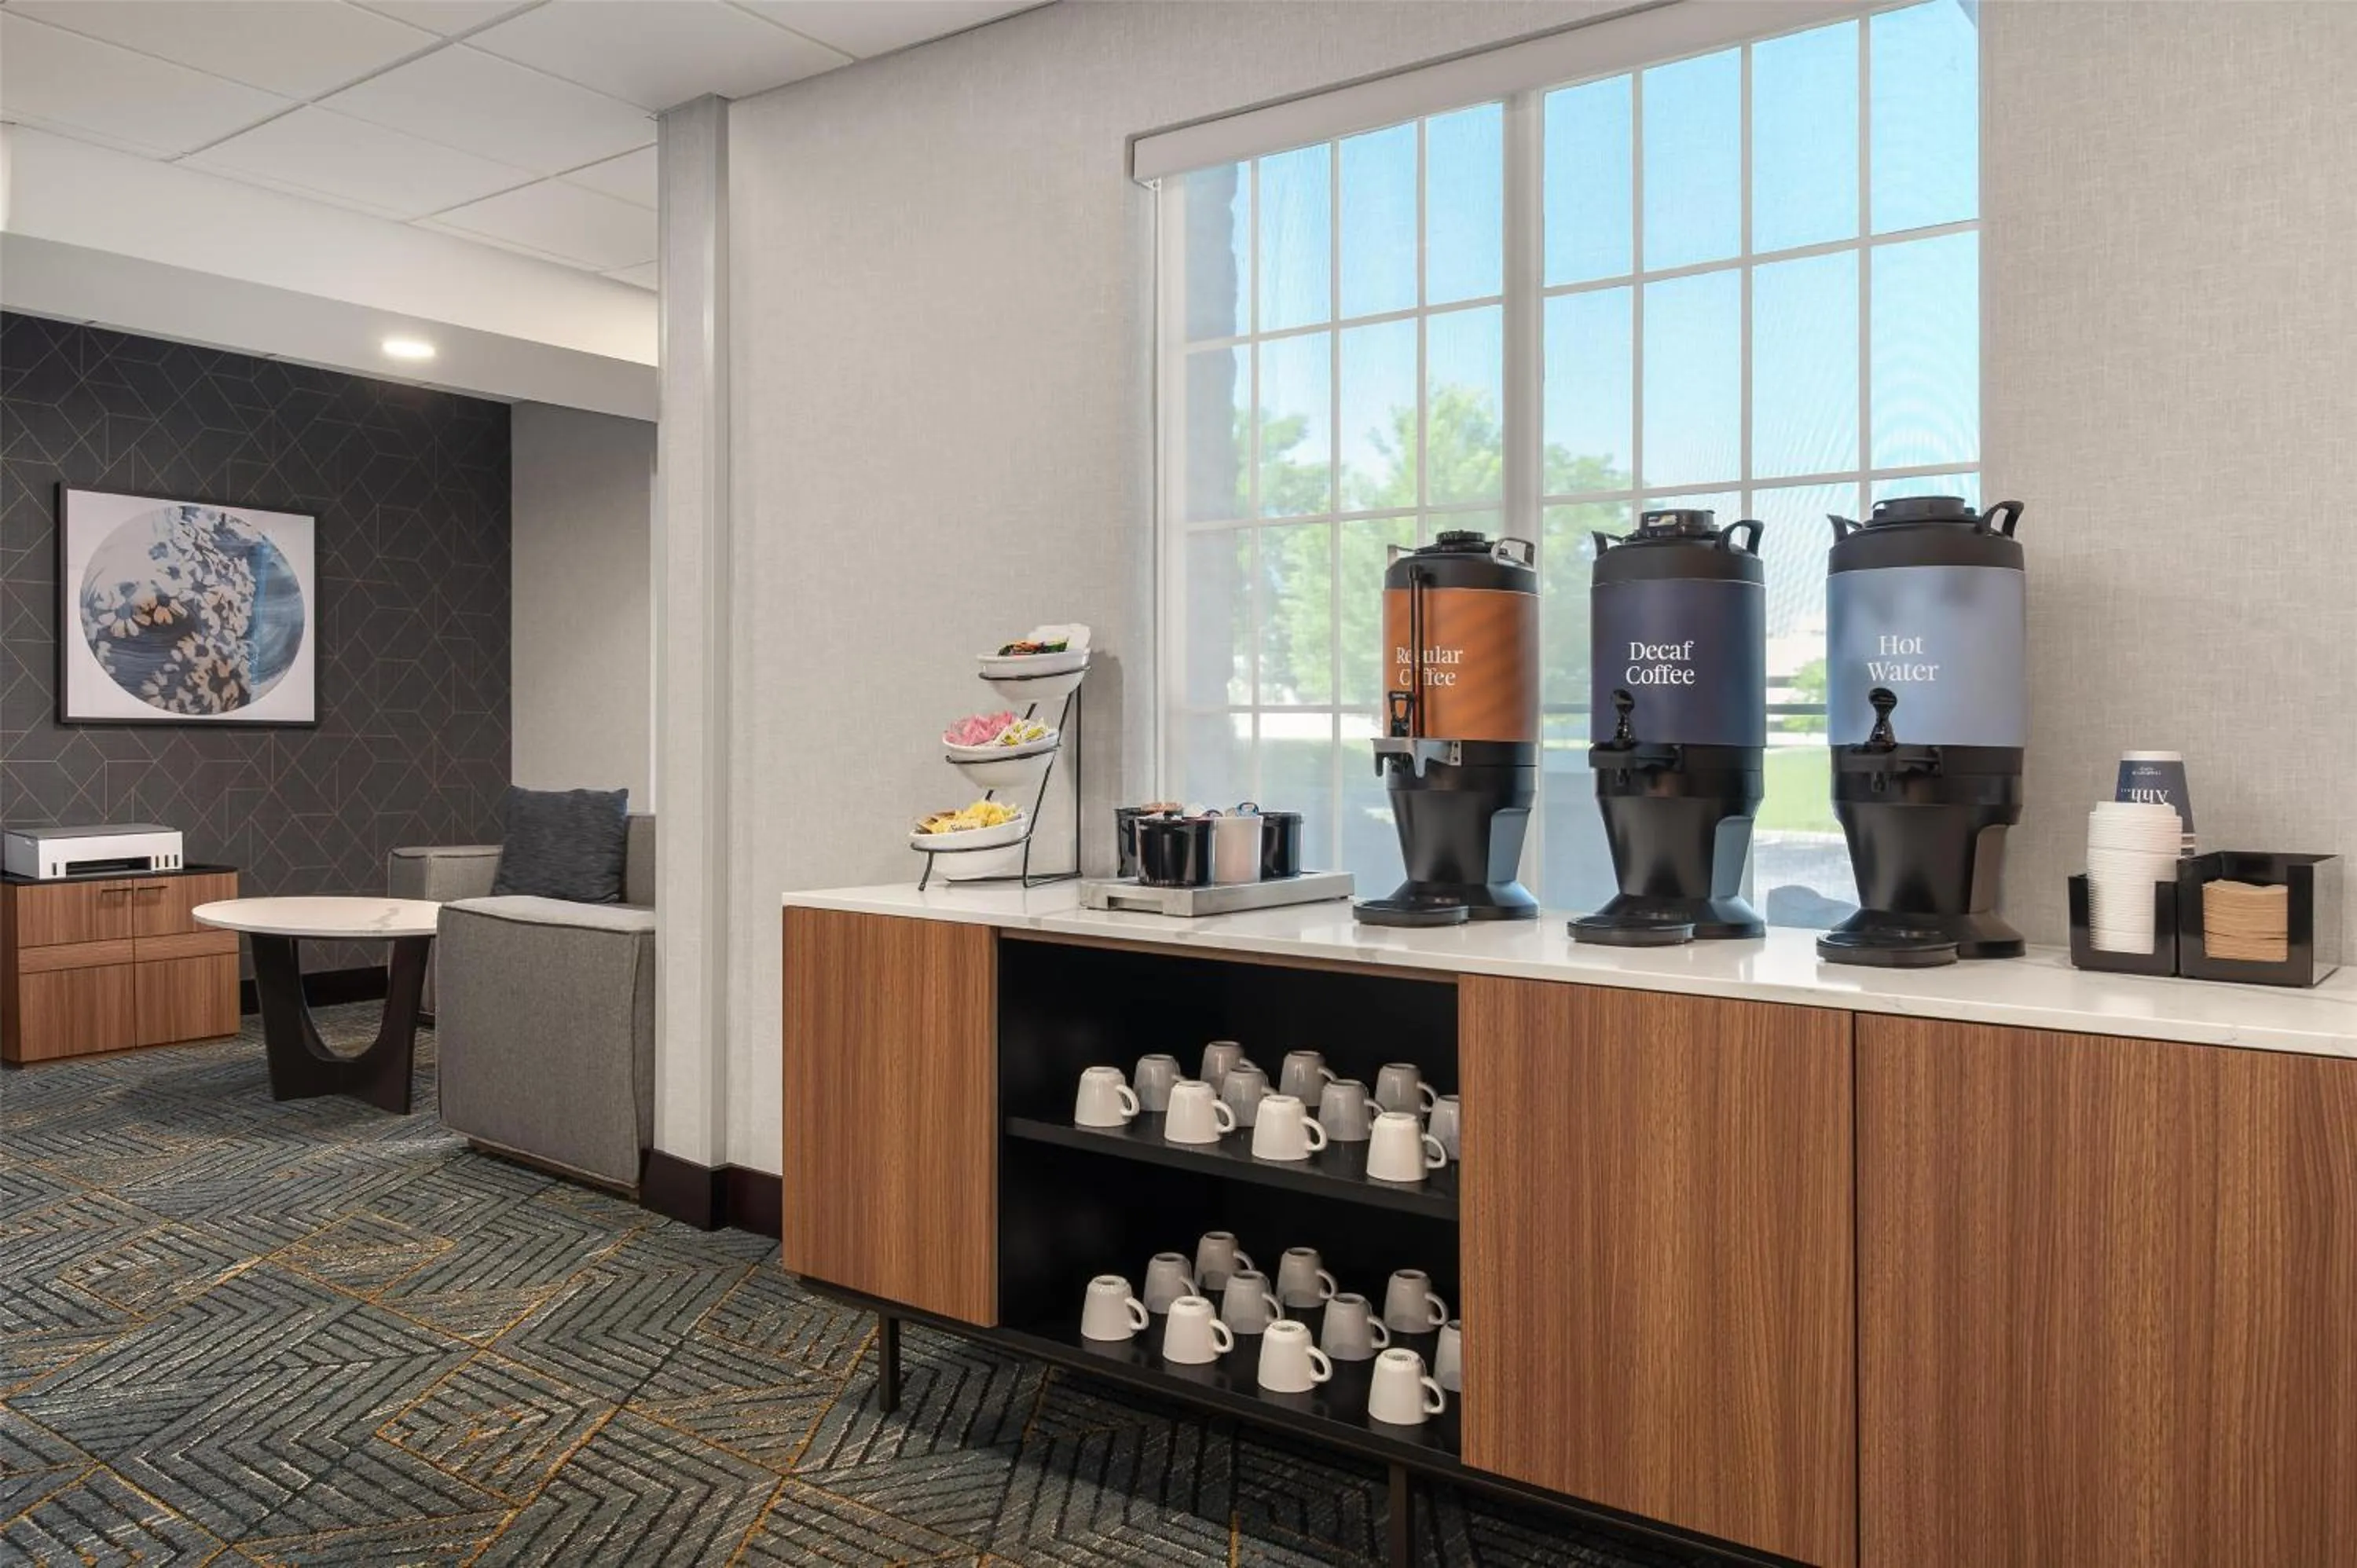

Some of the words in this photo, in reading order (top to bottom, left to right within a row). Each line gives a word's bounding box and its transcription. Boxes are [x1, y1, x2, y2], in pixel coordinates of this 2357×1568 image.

[1395, 645, 1464, 666] Reular
[1628, 640, 1695, 661] Decaf
[1879, 635, 1924, 656] Hot
[1398, 668, 1457, 686] Cffee
[1626, 665, 1695, 685] Coffee
[1867, 661, 1940, 682] Water
